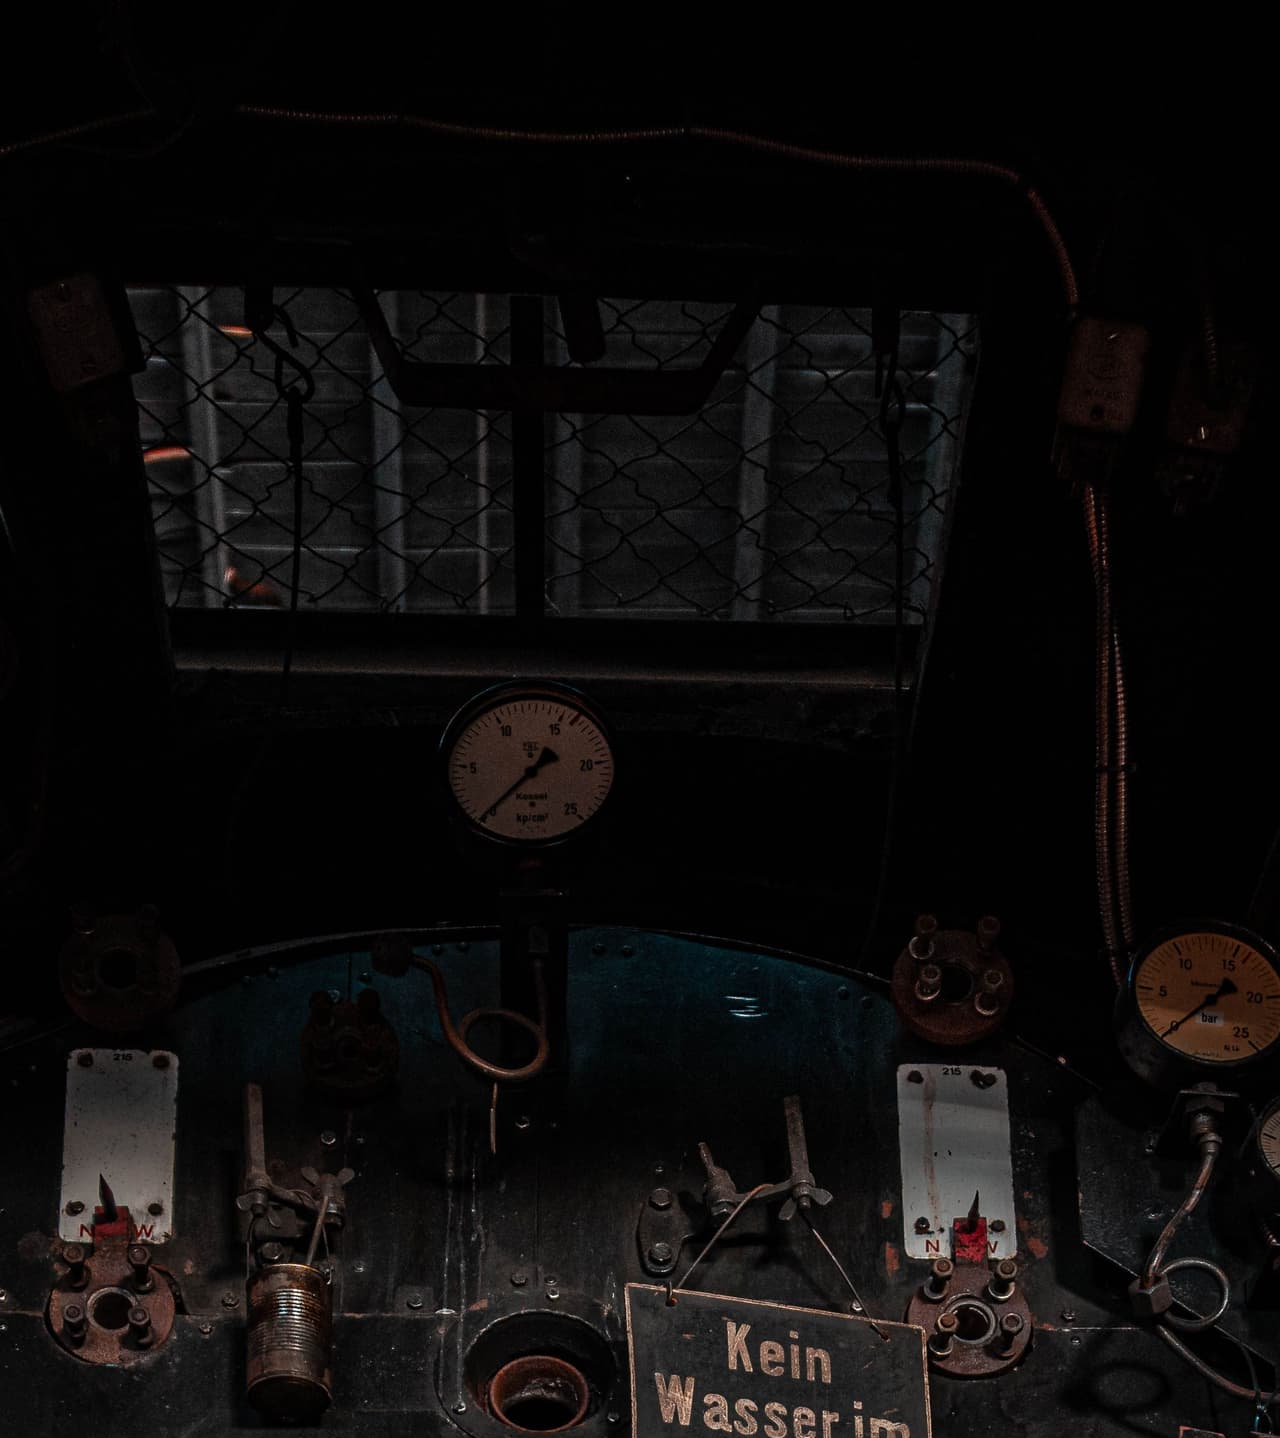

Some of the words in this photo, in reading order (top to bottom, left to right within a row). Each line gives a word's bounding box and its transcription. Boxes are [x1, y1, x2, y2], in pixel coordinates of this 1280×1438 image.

[500, 725, 512, 737] 10
[549, 723, 561, 735] 15
[470, 762, 477, 774] 5
[580, 759, 593, 771] 20
[564, 803, 578, 815] 25
[1179, 958, 1193, 971] 10
[1222, 959, 1236, 972] 15
[1159, 985, 1167, 997] 5
[1246, 991, 1263, 1004] 20
[1201, 1012, 1219, 1023] bar
[1233, 1026, 1249, 1039] 25
[114, 1053, 133, 1062] 215
[942, 1067, 962, 1076] 215
[925, 1239, 940, 1253] N
[726, 1320, 832, 1384] Kein
